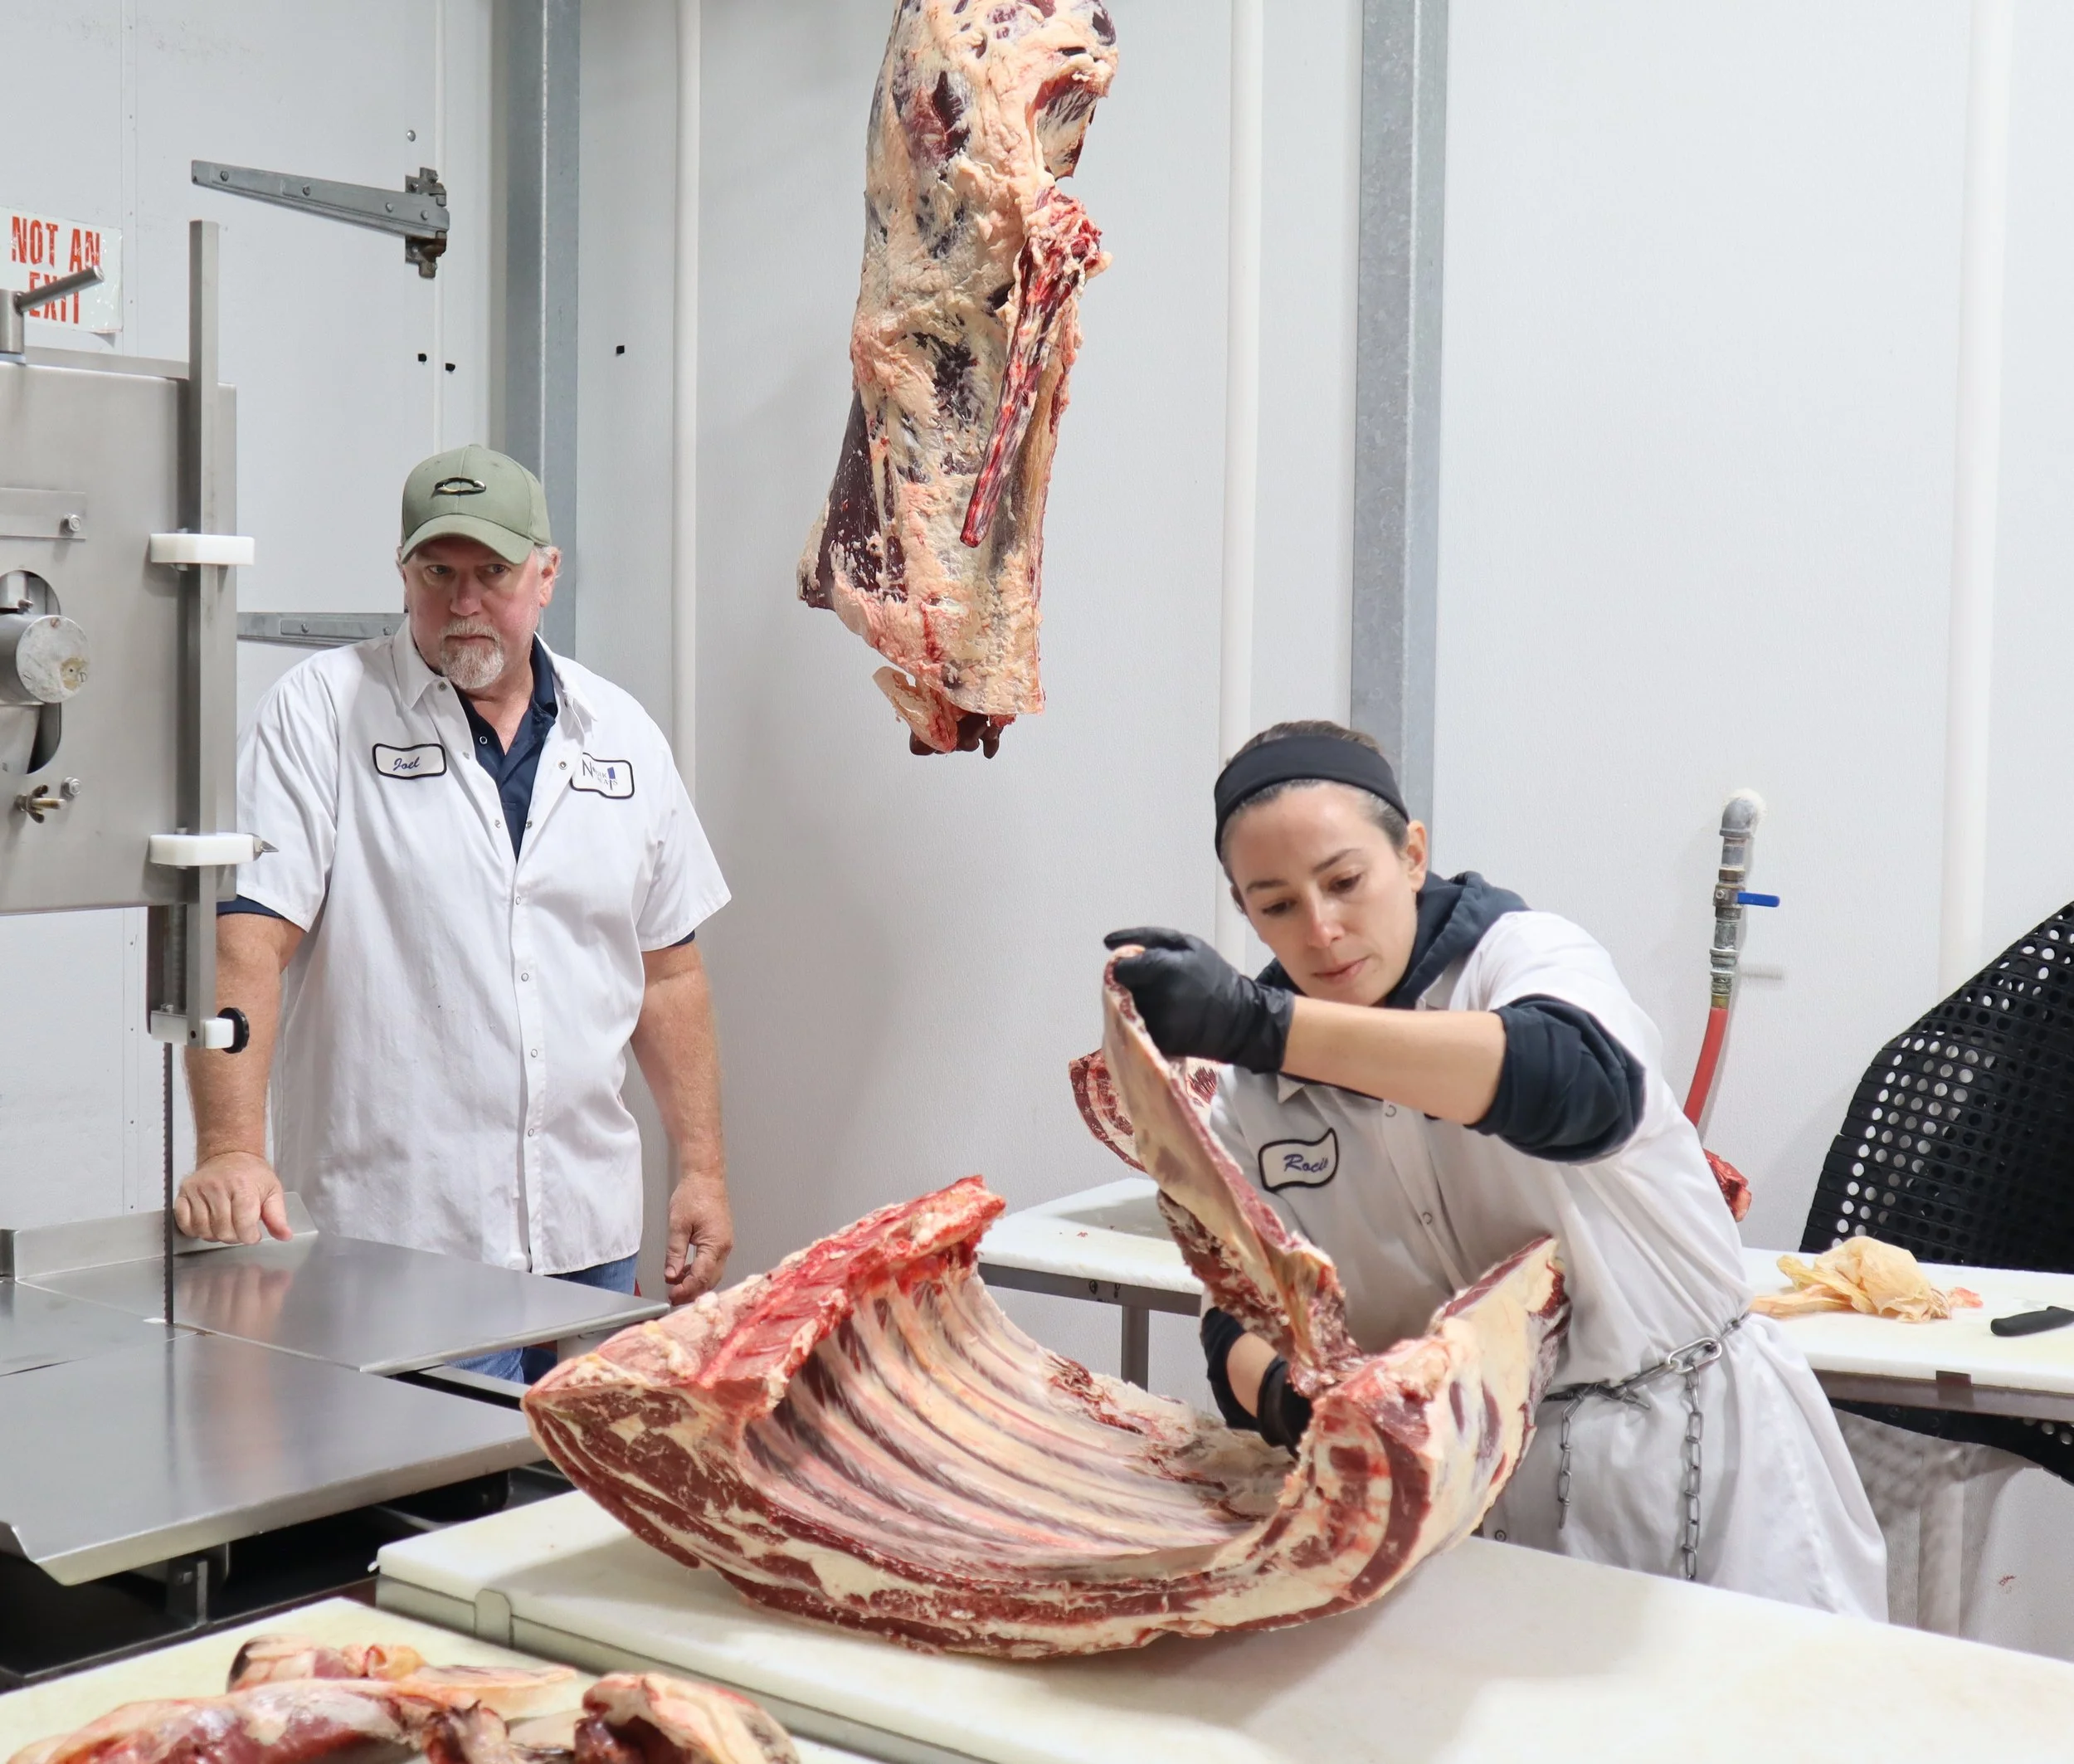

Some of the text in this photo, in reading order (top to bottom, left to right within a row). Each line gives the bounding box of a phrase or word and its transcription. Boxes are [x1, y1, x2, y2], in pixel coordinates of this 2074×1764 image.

[12, 216, 100, 272] NOT AN
[29, 271, 80, 324] EXIT
[392, 756, 420, 772] Joel
